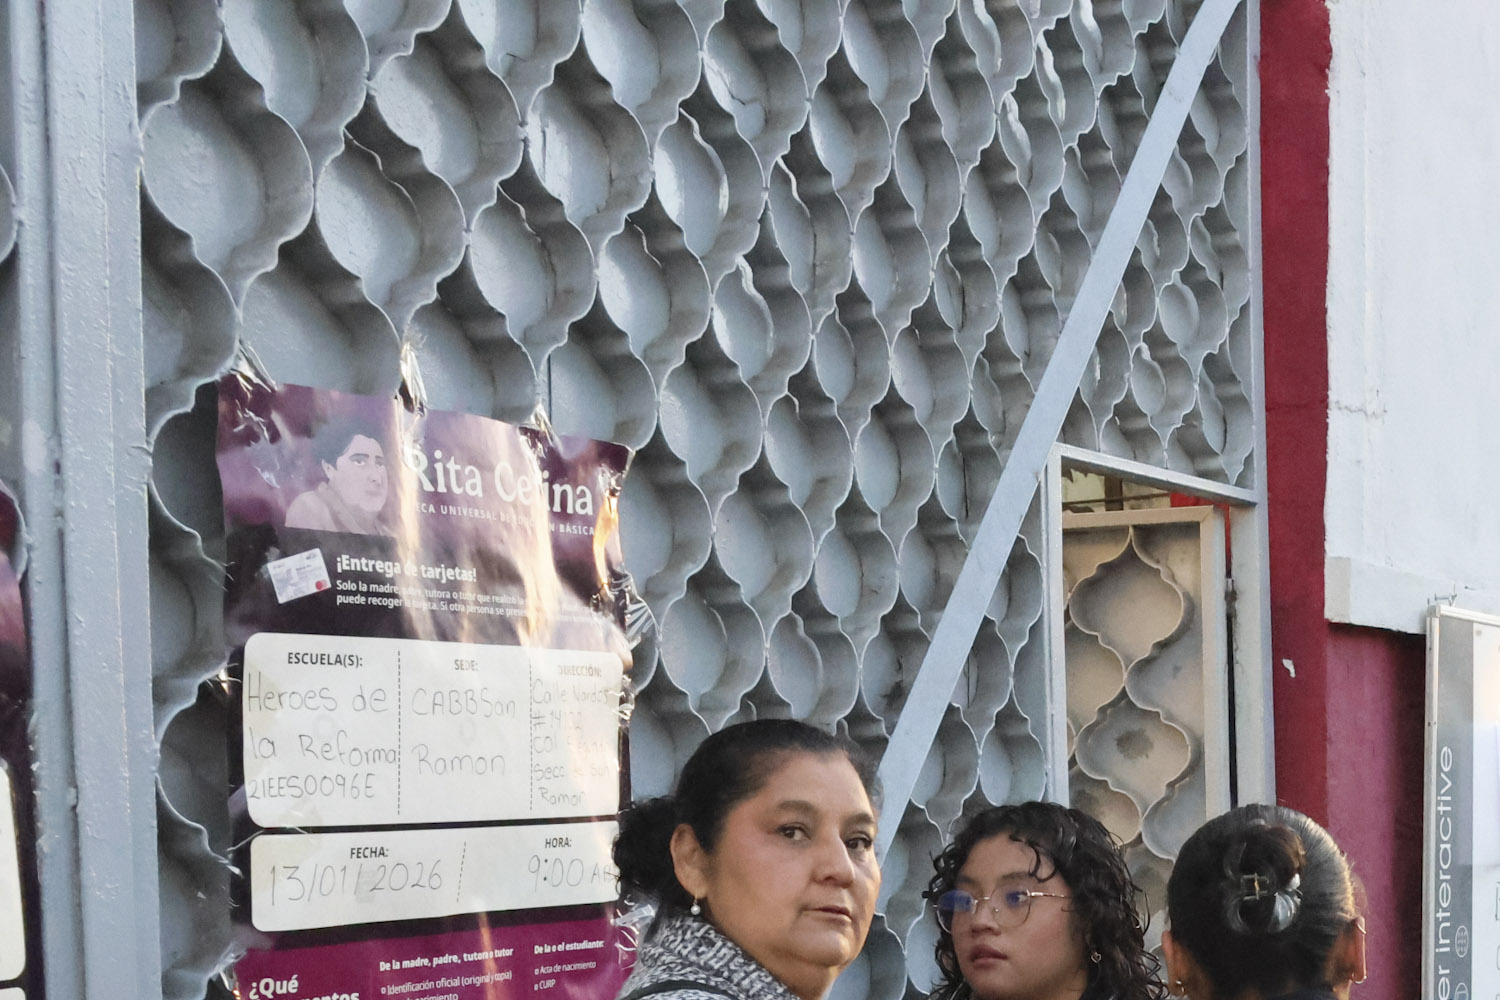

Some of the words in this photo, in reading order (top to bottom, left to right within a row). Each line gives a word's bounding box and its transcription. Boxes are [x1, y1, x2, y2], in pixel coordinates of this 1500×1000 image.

[408, 446, 483, 498] Rita
[494, 460, 594, 516] Ceina
[440, 504, 497, 521] UNIVERSAL
[559, 522, 595, 536] BÁSICA
[336, 554, 401, 578] ¡Entrega
[420, 564, 477, 584] tarjetas!
[336, 580, 357, 591] Solo
[358, 581, 368, 592] la
[425, 590, 451, 599] tutora
[477, 594, 491, 604] que
[336, 595, 367, 606] puede
[368, 596, 402, 609] recoger
[440, 601, 448, 610] Si
[449, 602, 465, 612] otra
[466, 606, 494, 616] persona
[287, 652, 363, 669] ESCUELA(S):
[454, 659, 479, 672] SEDE:
[248, 671, 338, 712] Heroes
[352, 684, 388, 713] de
[248, 726, 277, 760] la
[298, 729, 397, 767] Reforma
[411, 743, 506, 776] Ramon
[350, 846, 389, 860] FECHA:
[545, 836, 573, 849] HORA:
[1435, 746, 1453, 953] interactive
[270, 858, 444, 907] 13/01/2026
[528, 854, 585, 894] 9:00
[379, 961, 391, 972] De
[392, 959, 401, 970] la
[402, 956, 431, 969] madre,
[432, 954, 461, 968] padre,
[494, 948, 514, 958] tutor
[534, 945, 544, 955] De
[544, 943, 551, 953] la
[551, 944, 557, 953] o
[557, 941, 565, 951] el
[540, 965, 553, 975] Acta
[553, 963, 562, 973] de
[562, 961, 597, 972] nacimiento
[249, 974, 299, 1000] ¿Qué
[387, 980, 435, 995] Identificación
[436, 976, 460, 988] oficial
[461, 972, 490, 988] (original
[539, 978, 556, 990] CURP
